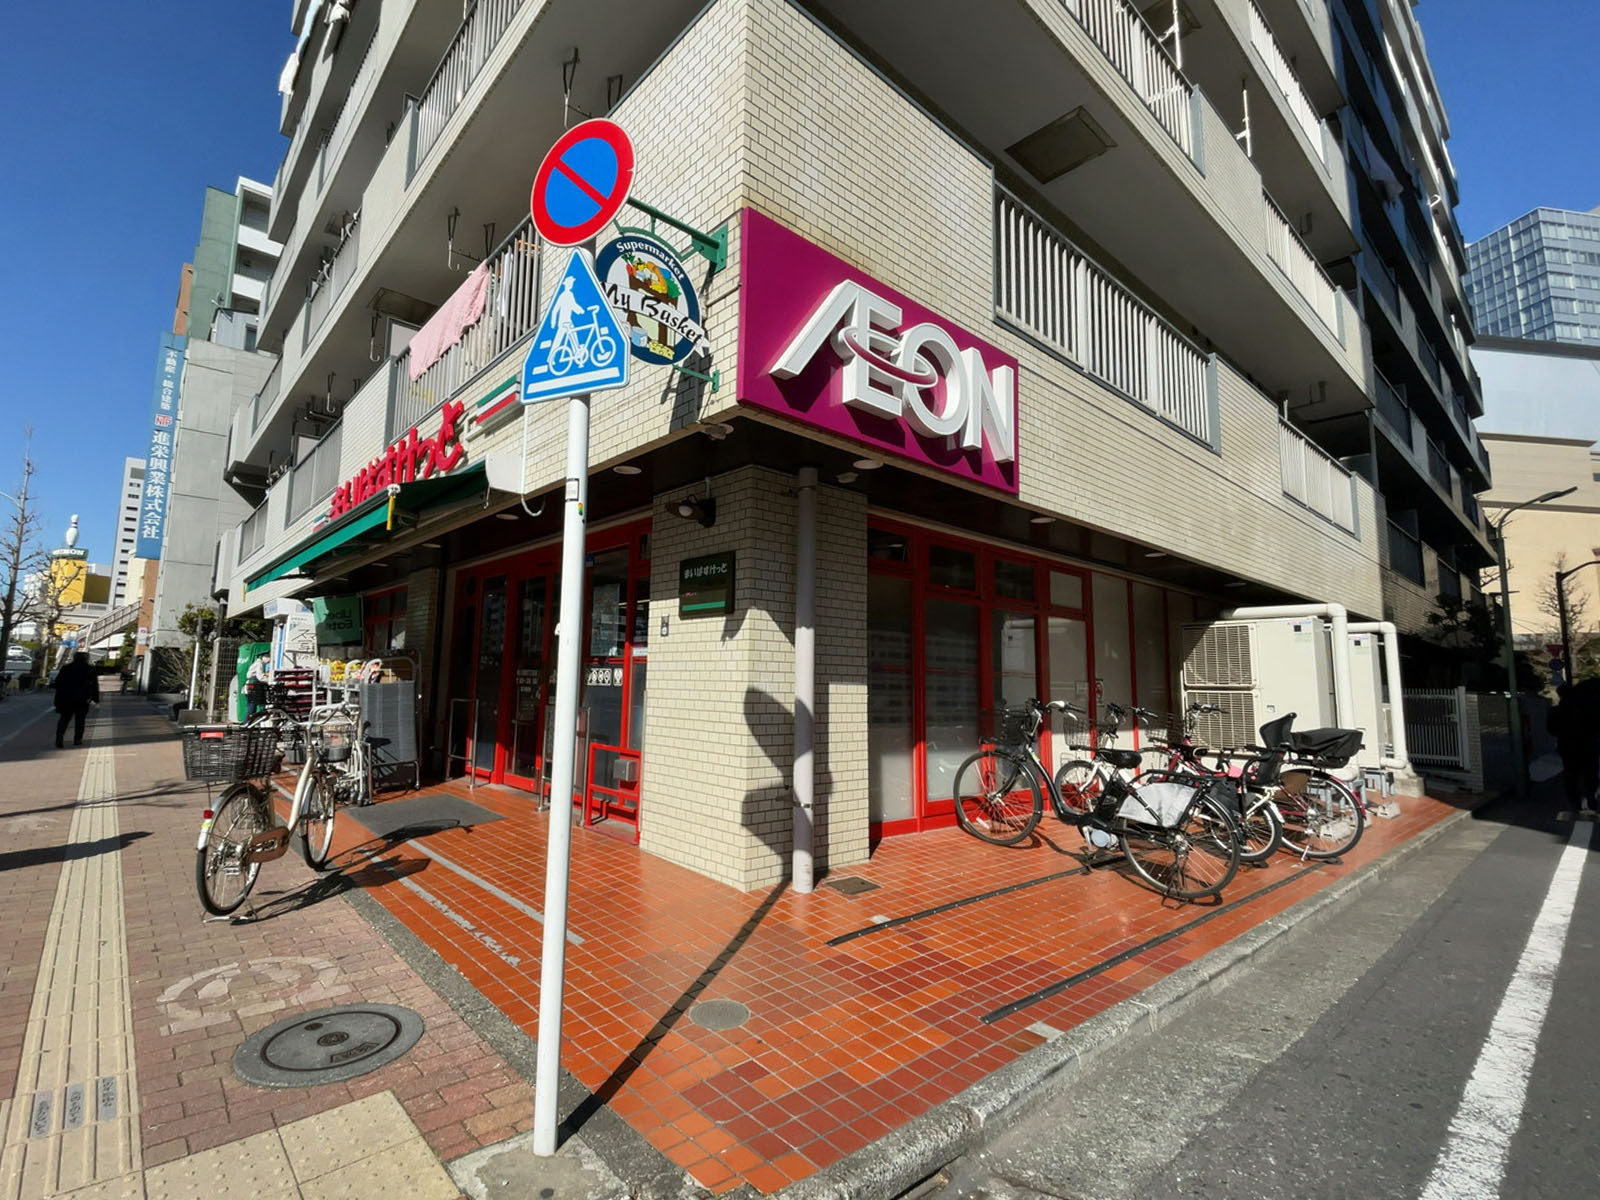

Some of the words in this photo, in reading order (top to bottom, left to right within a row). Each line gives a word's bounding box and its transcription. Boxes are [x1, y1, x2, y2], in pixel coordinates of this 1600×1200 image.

[616, 241, 685, 280] Supermarket
[601, 282, 631, 312] My
[641, 295, 704, 344] Basket
[769, 279, 1014, 463] AEON
[142, 430, 170, 539] 進栄興業株式会社
[329, 400, 465, 522] まいばすけっと
[683, 562, 729, 580] まいばすけっと
